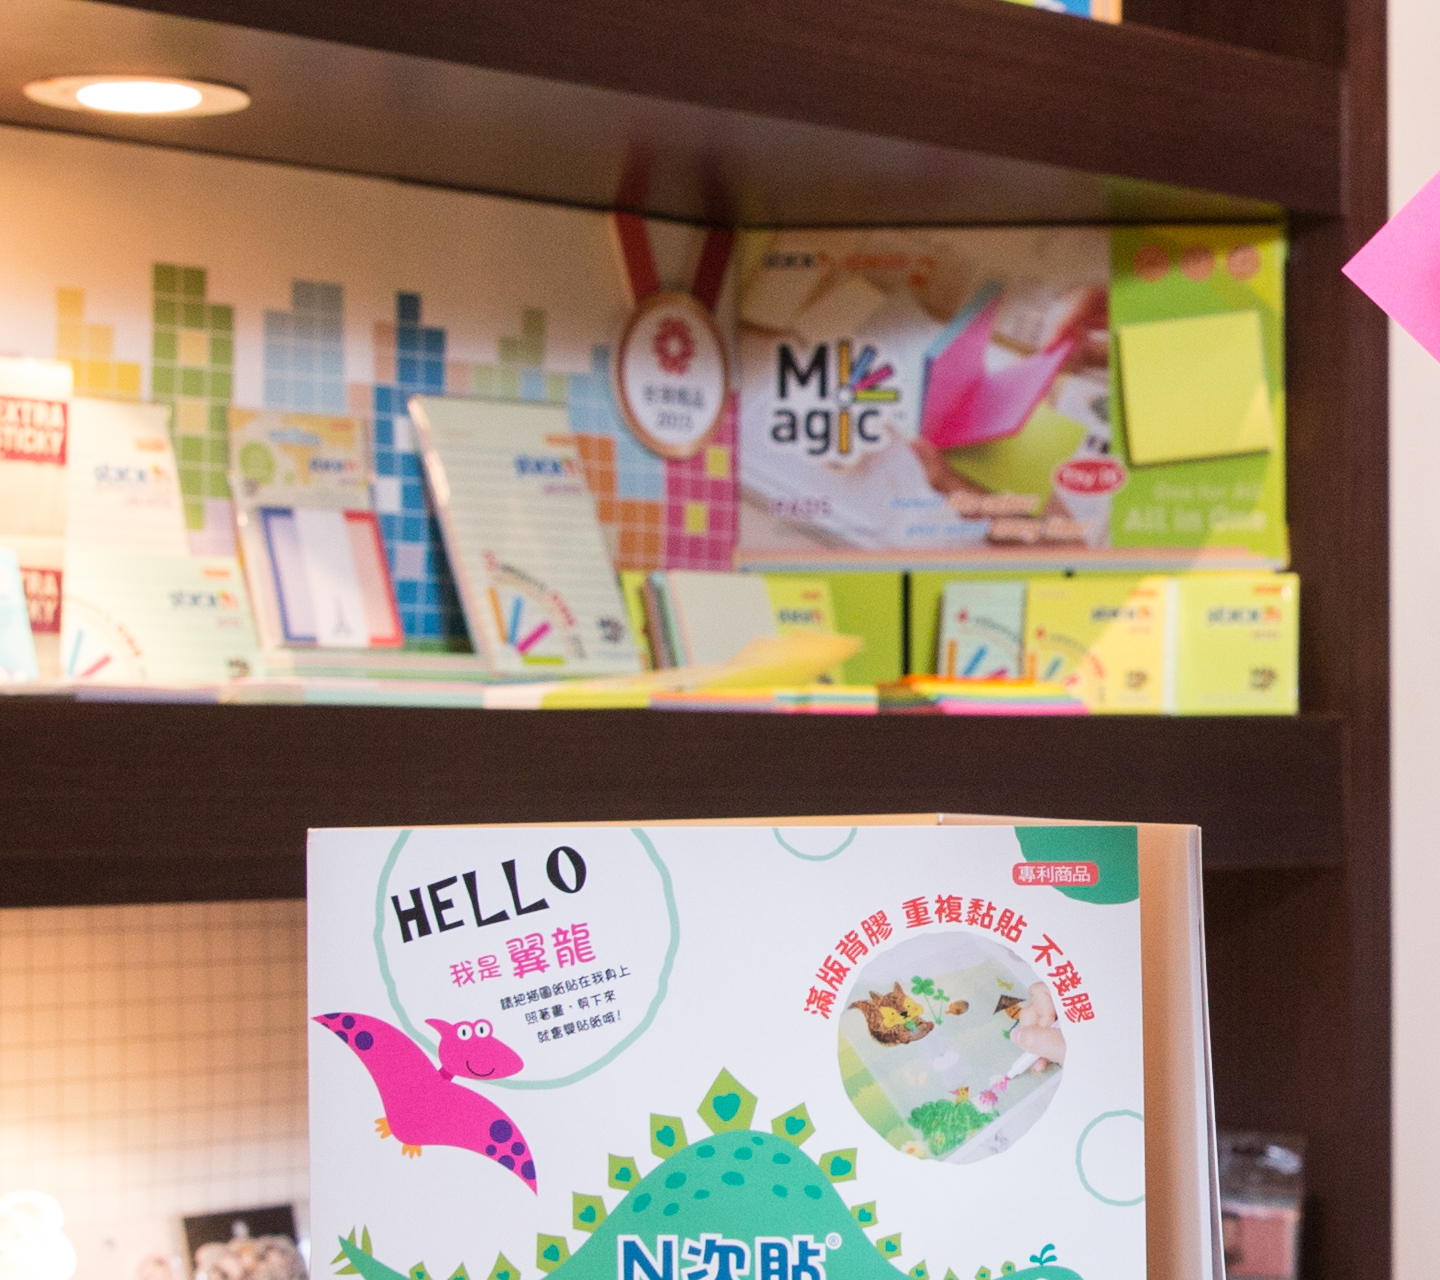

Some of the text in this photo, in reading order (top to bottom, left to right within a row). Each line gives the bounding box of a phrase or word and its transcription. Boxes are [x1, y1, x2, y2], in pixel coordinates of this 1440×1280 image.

[390, 845, 587, 944] HELLO
[1017, 864, 1092, 884] 專利商品
